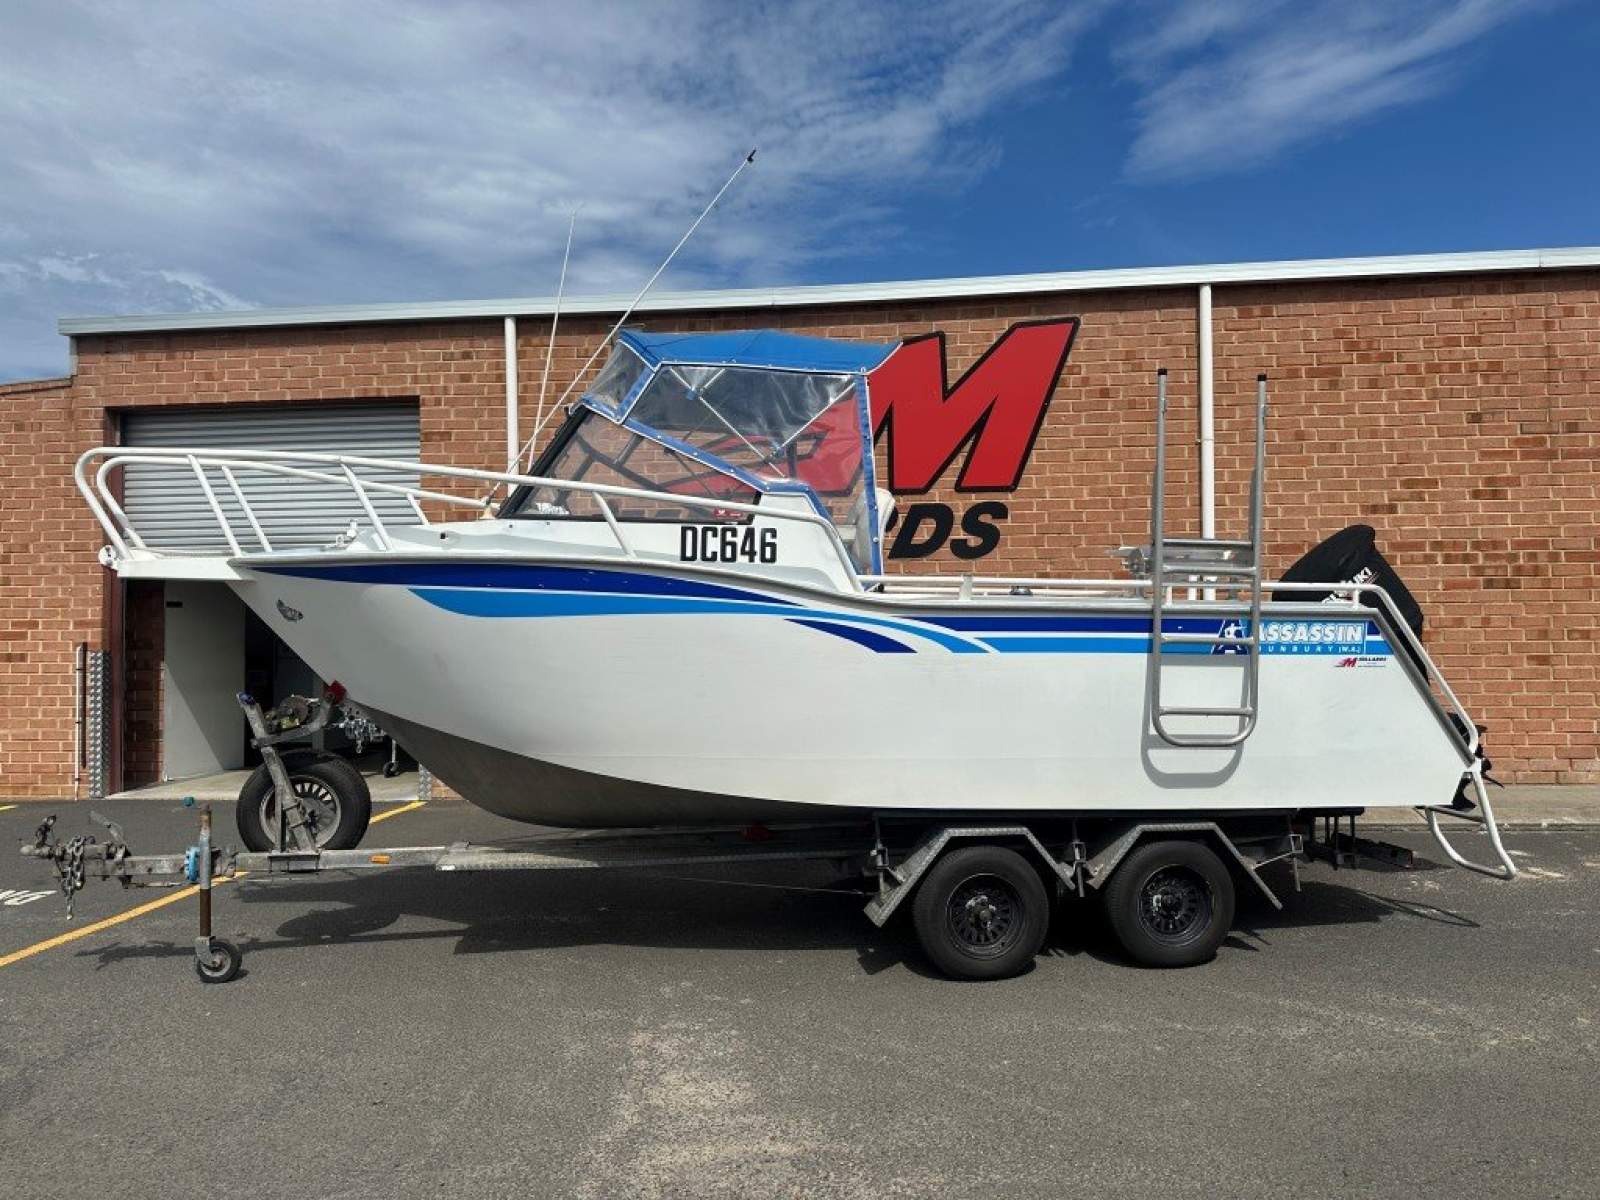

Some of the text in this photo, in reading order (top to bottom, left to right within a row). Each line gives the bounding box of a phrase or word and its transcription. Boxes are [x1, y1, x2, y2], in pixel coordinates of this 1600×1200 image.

[680, 525, 778, 564] DC646
[885, 501, 1009, 560] DS
[1259, 645, 1335, 653] UNBURY
